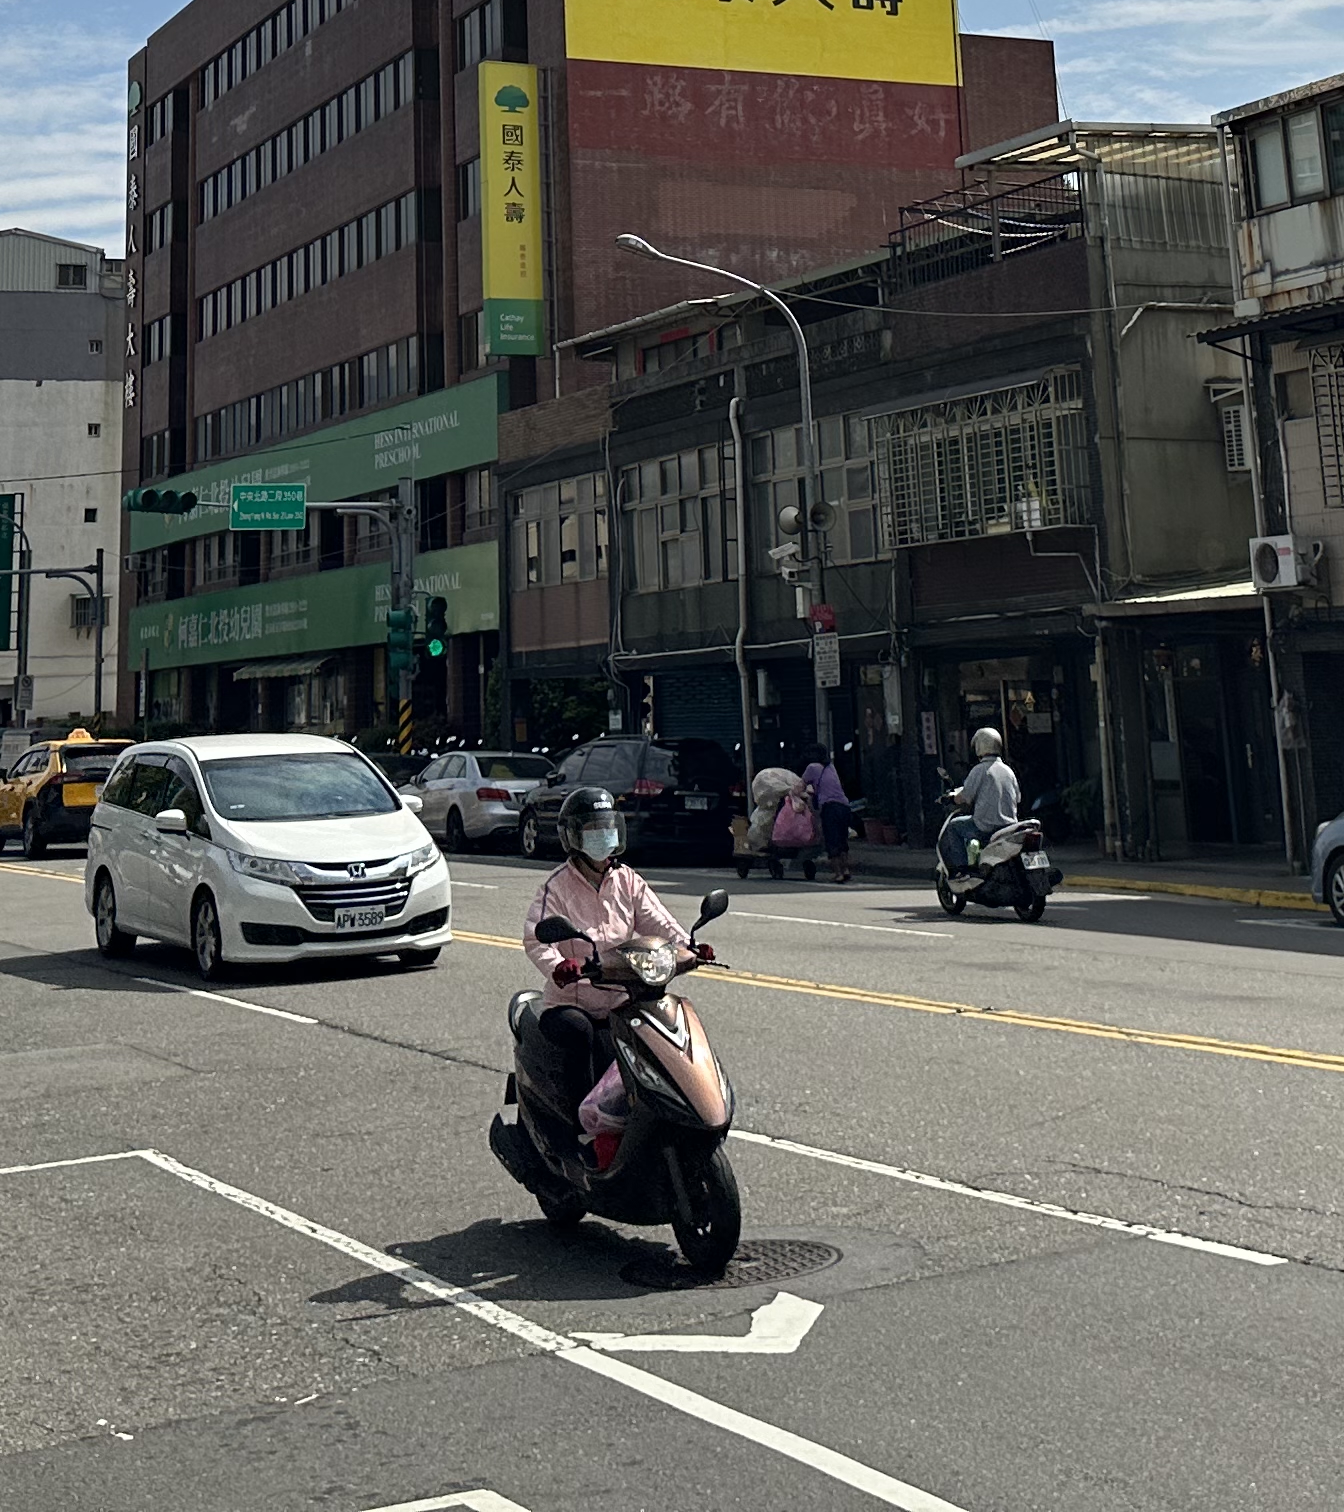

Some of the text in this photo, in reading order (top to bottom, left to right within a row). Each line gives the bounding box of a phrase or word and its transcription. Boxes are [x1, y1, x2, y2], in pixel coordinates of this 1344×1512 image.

[502, 124, 526, 224] 國泰人壽
[499, 313, 525, 323] Cathay
[499, 324, 514, 332] Life
[499, 332, 535, 341] Insurance
